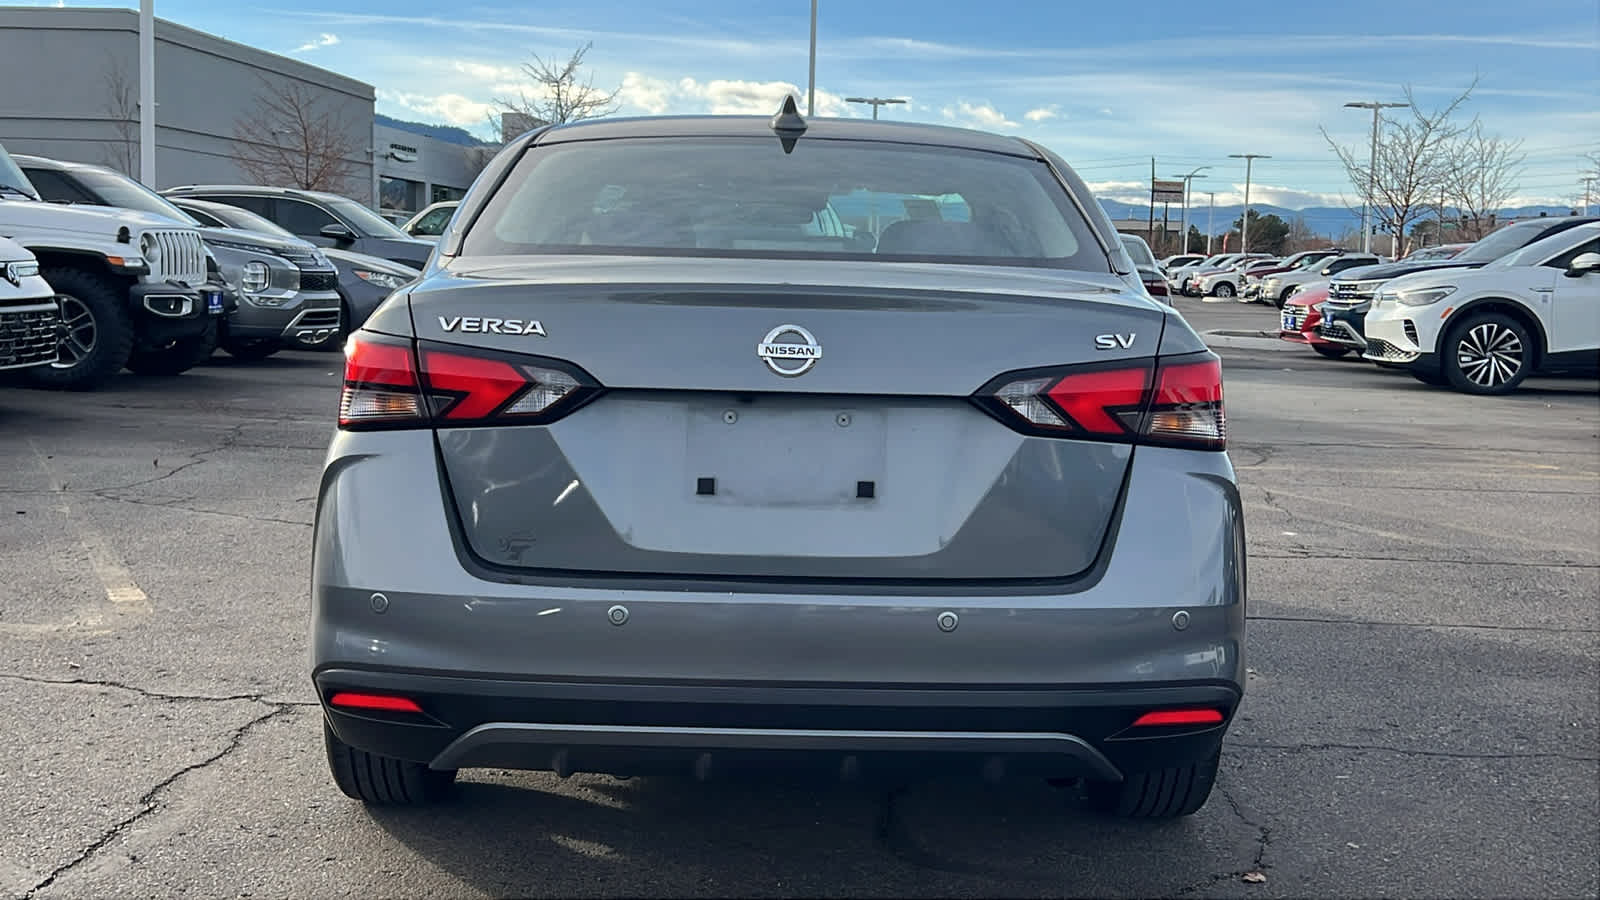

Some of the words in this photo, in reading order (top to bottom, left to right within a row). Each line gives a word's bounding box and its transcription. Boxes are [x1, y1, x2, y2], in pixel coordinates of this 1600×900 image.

[438, 316, 547, 337] VERSA
[1095, 333, 1136, 350] SV
[765, 346, 815, 356] NISSAN
